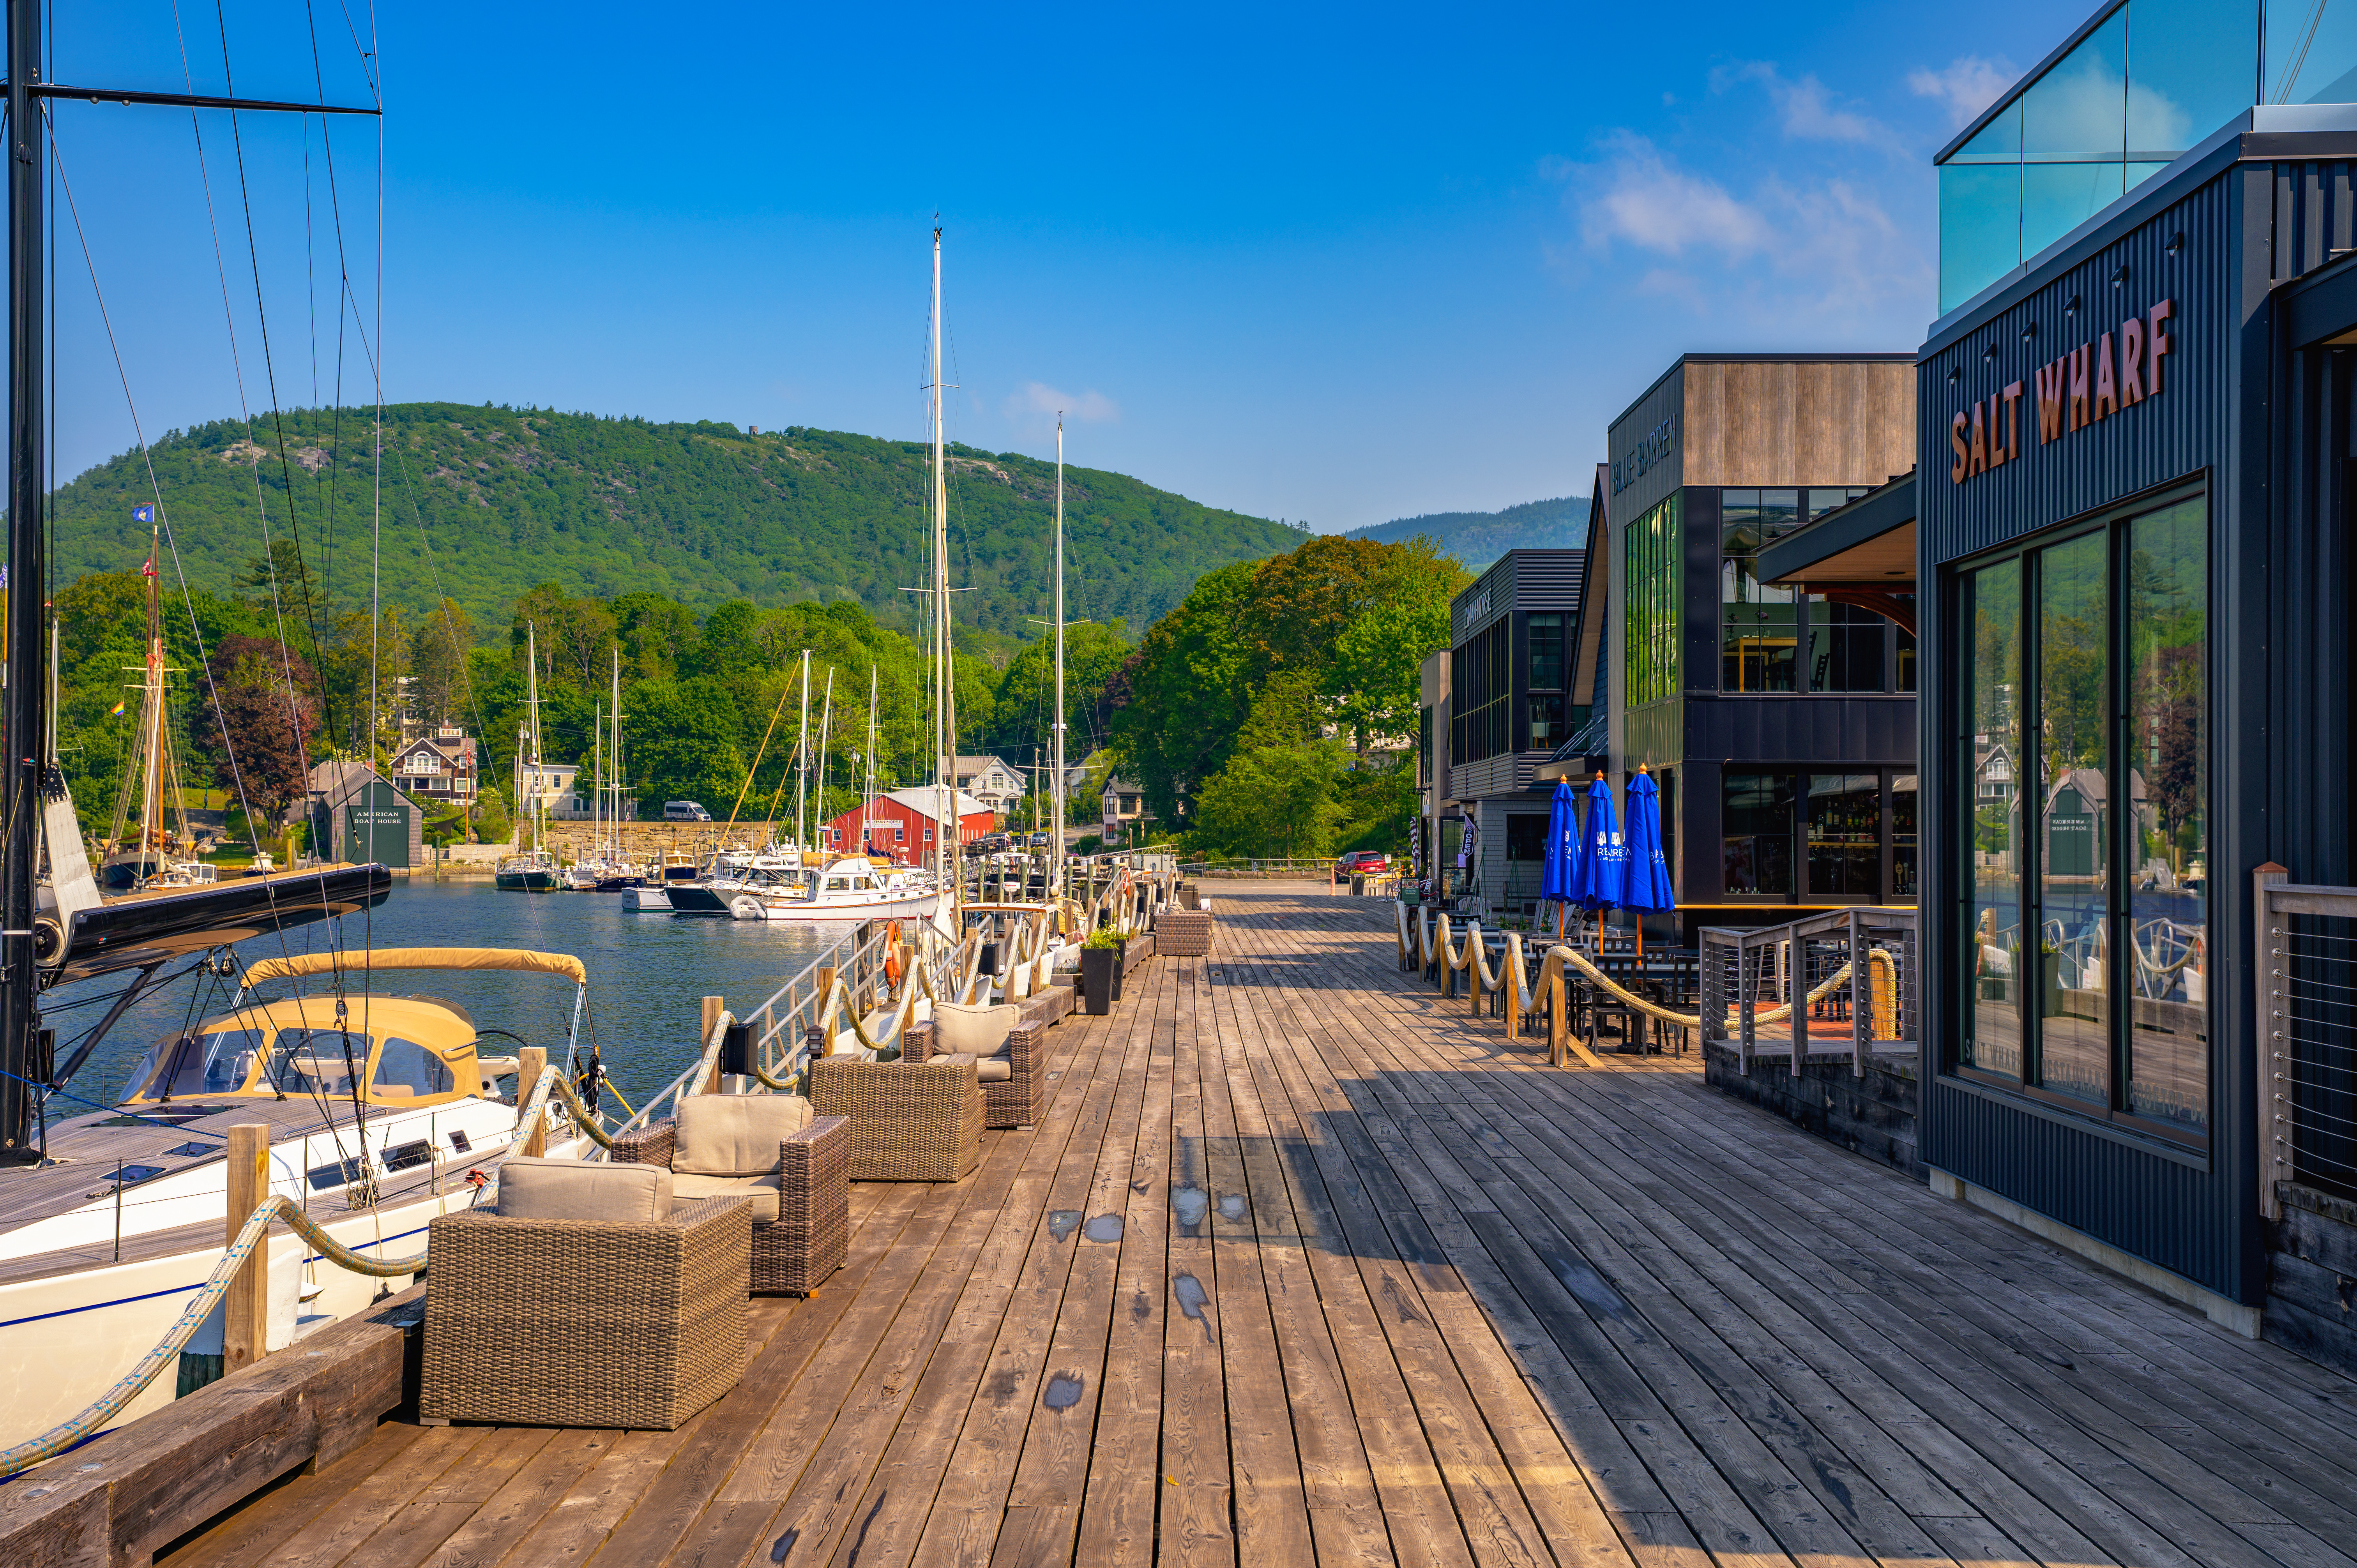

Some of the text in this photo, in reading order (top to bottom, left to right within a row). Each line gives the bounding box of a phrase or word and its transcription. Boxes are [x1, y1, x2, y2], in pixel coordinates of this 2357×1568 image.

[1951, 298, 2171, 484] SALT WHARF
[1612, 413, 1676, 496] BLUE BARREN
[1464, 833, 1472, 854] OPEN
